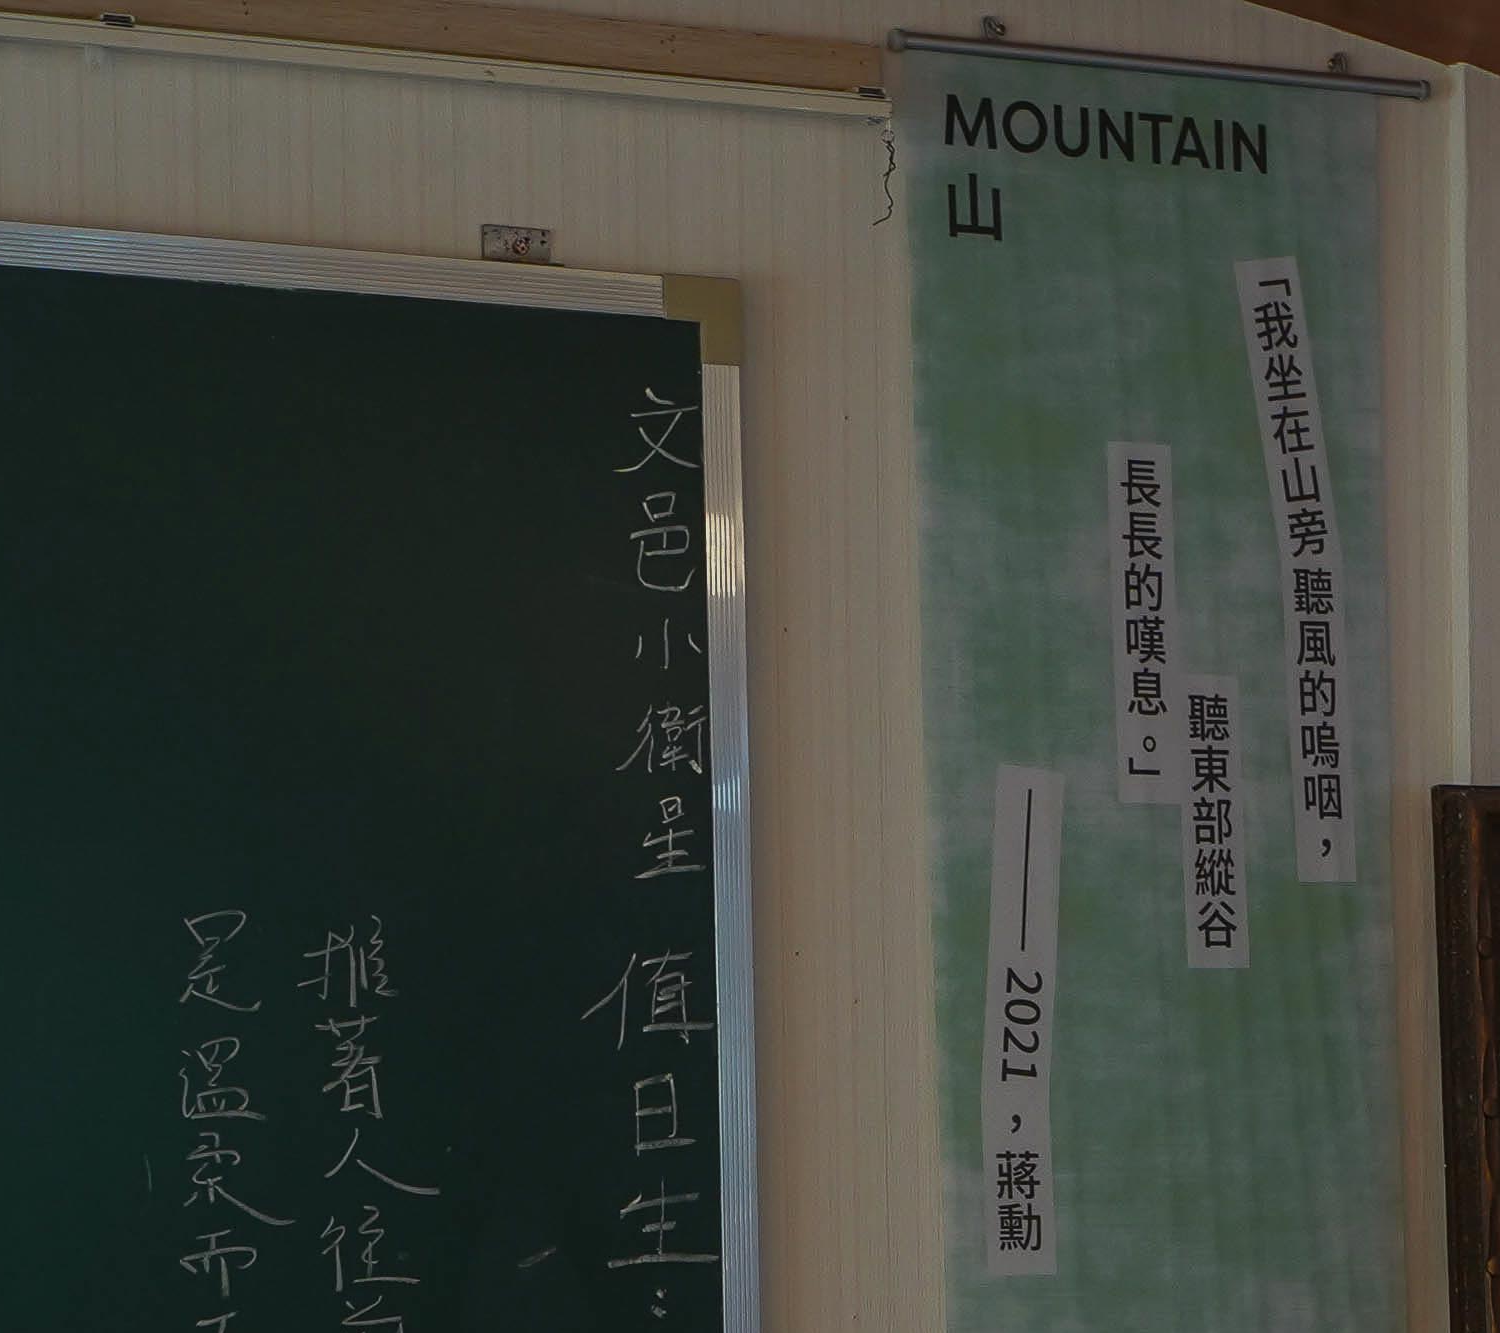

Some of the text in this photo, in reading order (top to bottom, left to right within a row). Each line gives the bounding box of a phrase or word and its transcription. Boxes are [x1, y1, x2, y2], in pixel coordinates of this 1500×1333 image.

[943, 93, 1269, 174] MOUNTAIN
[948, 173, 1004, 242] 山
[1119, 458, 1170, 778] 長長的嘆息。」
[1187, 693, 1238, 950] 聽東部縱谷
